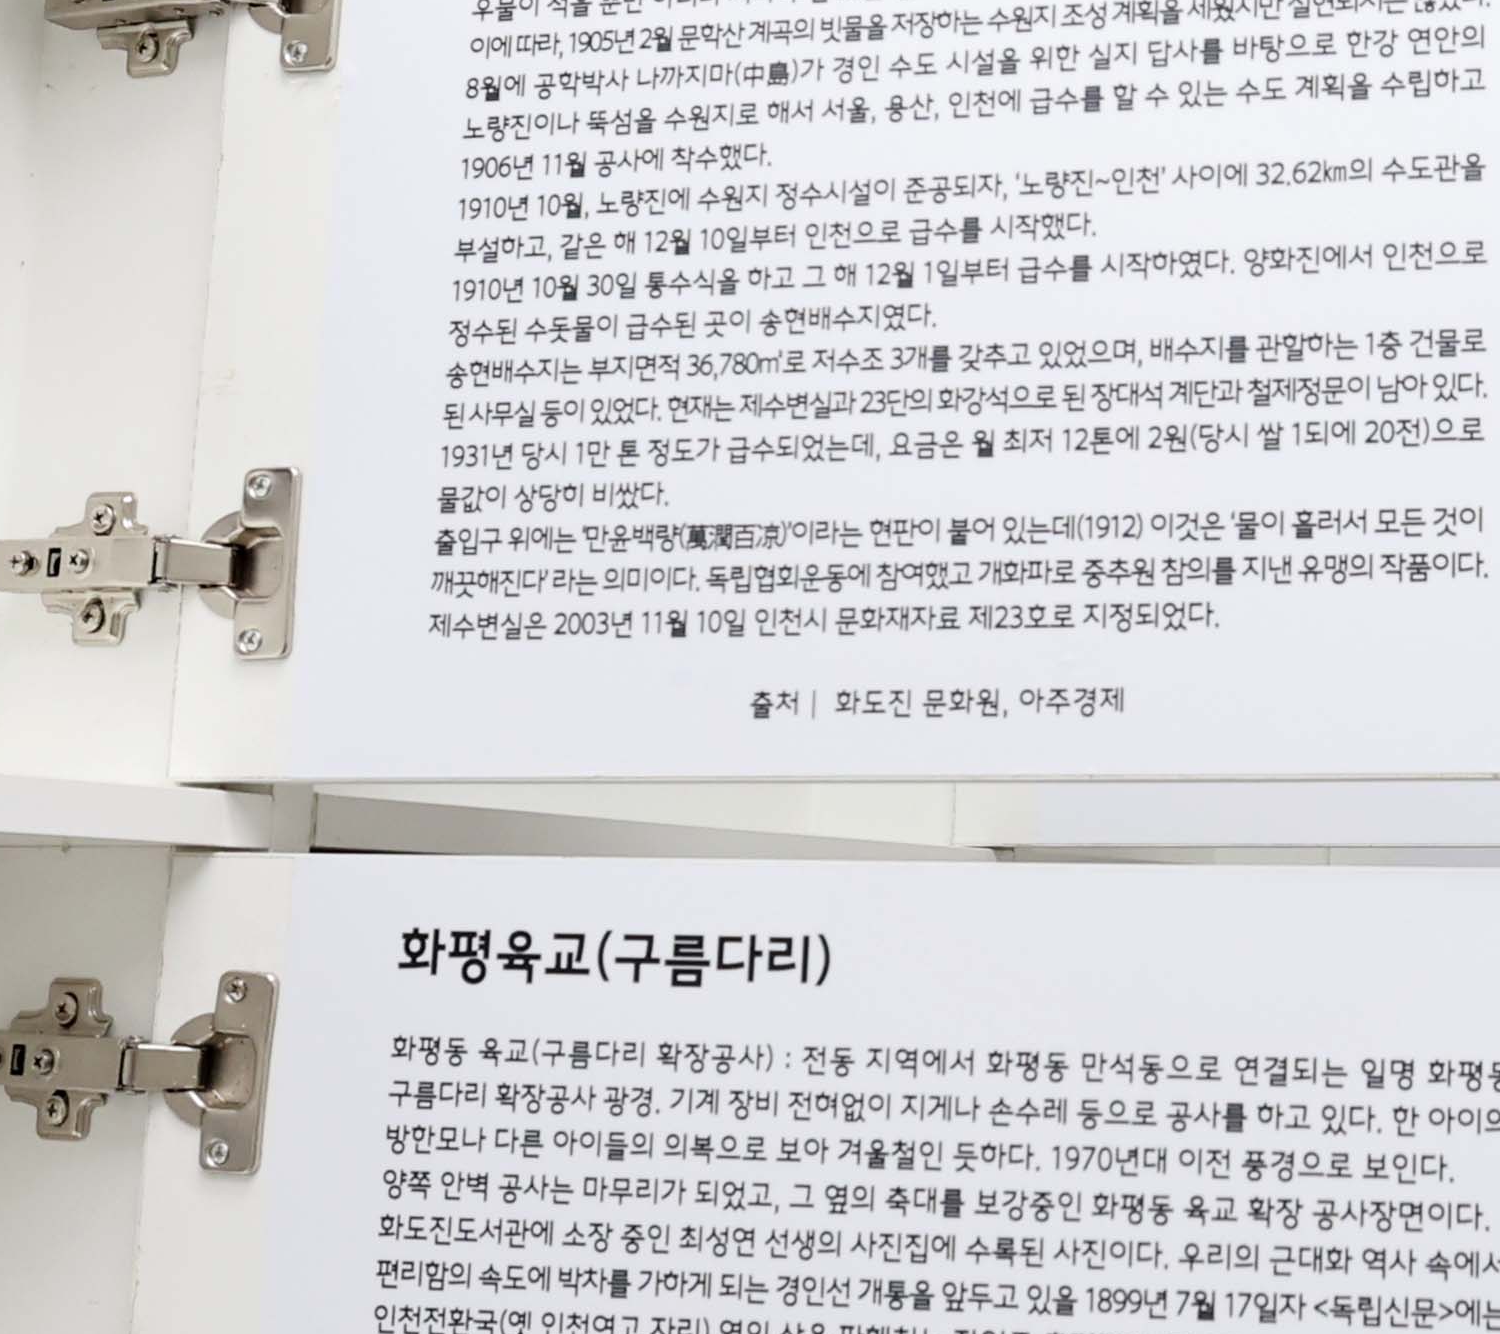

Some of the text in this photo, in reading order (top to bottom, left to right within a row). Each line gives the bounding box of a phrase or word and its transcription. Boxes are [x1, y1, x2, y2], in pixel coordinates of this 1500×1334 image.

[460, 141, 773, 182] 1906년 11월 공사에 착수했다.
[452, 211, 1097, 265] 부설하고, 같은 해 12월 10일부터 인천으로 급수를 시작했다.
[447, 302, 938, 349] 정수된 수돗물이 급수된 곳이 송현배수지였다.
[435, 480, 670, 516] 물값이 상당히 비쌌다.
[427, 600, 1221, 642] 제수변실은 2003년 11월 10일 인천시 문화재자료 제23호로 지정되었다.
[749, 686, 1125, 721] 출처 화도진 문화원, 아주경제
[396, 925, 832, 989] 화평육교(구름다리)
[385, 1123, 1456, 1186] 방한모나 다른 아이들의 의복으로 보아 겨울철인 듯하다. 1970년대 이전 풍경으로 보인다.
[376, 1212, 555, 1250] 화도진도서관에
[560, 1220, 615, 1255] 소장
[619, 1222, 671, 1256] 중인
[678, 1224, 757, 1259] 최성연
[764, 1227, 843, 1263] 선생의
[849, 1231, 957, 1265] 사진집에
[964, 1235, 1045, 1269] 수록된
[1052, 1238, 1170, 1272] 사진이다.
[1177, 1241, 1260, 1273] 우리의
[1268, 1244, 1354, 1278] 근대화
[1360, 1246, 1418, 1281] 역사
